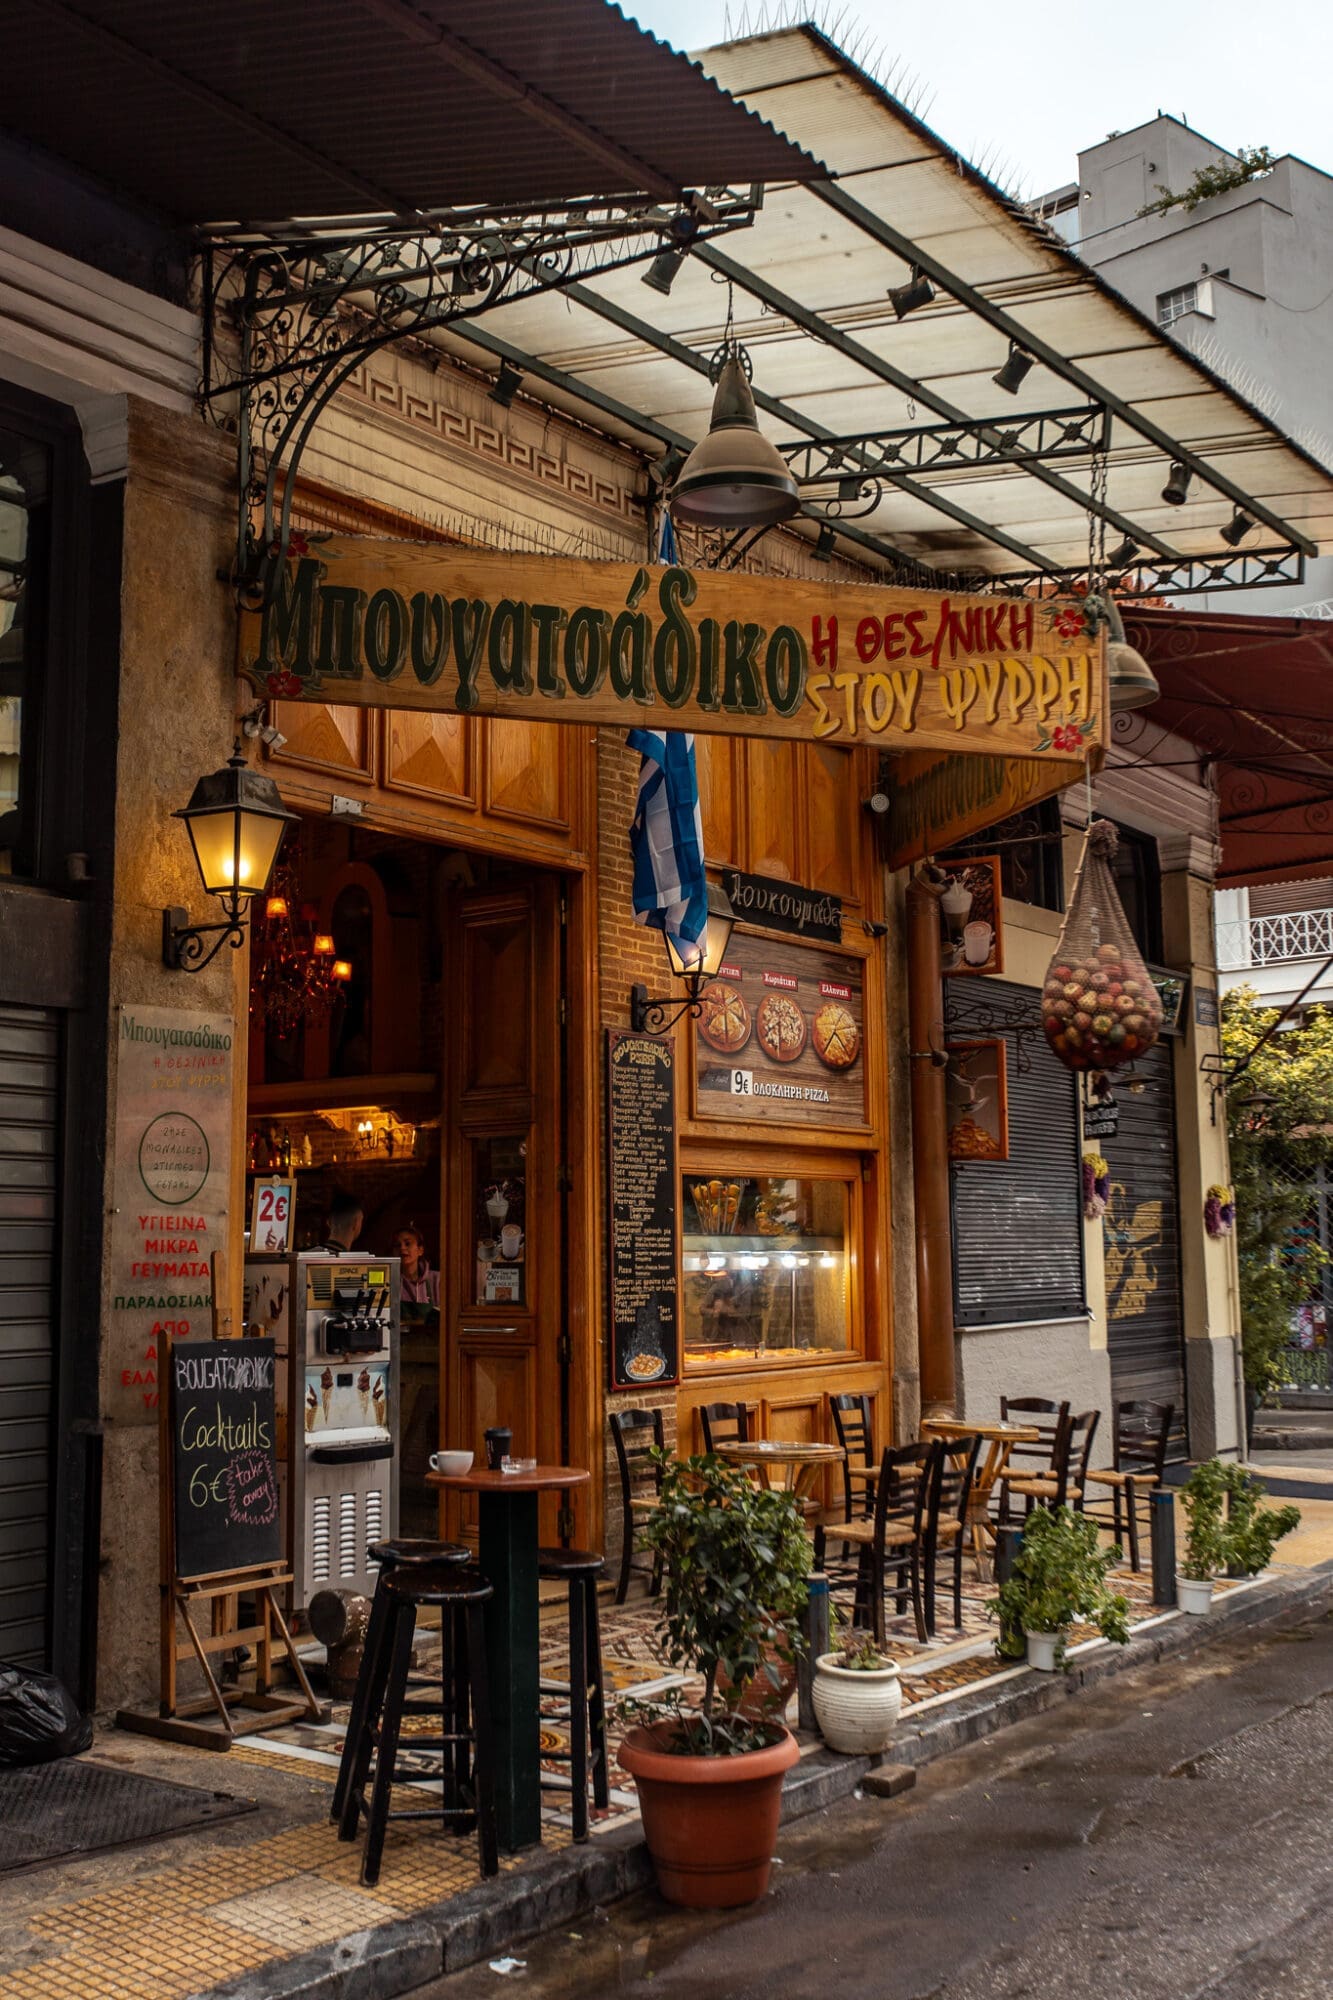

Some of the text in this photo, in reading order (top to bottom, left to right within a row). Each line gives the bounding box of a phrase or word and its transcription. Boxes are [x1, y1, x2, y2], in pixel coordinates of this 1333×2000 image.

[252, 555, 808, 718] Μπουγατσάδικο
[811, 598, 1034, 672] Η ΘΕΣ/ΝΙΚΗ
[805, 653, 1094, 738] ΣΤΟΥ ΨΥΡΡΗ
[120, 1015, 231, 1051] Μπουγατσάδικο
[734, 1071, 750, 1094] 9€
[753, 1082, 803, 1100] ΟΛΟΚΛΗΡΗ
[804, 1086, 830, 1102] PIZZA
[260, 1190, 287, 1222] 2€
[138, 1215, 207, 1231] ΥΓΙΕΙΝΑ
[145, 1239, 199, 1254] ΜΙΚΡΑ
[132, 1262, 210, 1278] ΓΕΥΜΑΤΑ
[114, 1295, 213, 1310] ΠΑΡΑΔΟΣΙΑΚ
[181, 1401, 271, 1453] Cocktails
[190, 1463, 229, 1508] 6€
[235, 1457, 264, 1487] take
[243, 1482, 272, 1513] away
